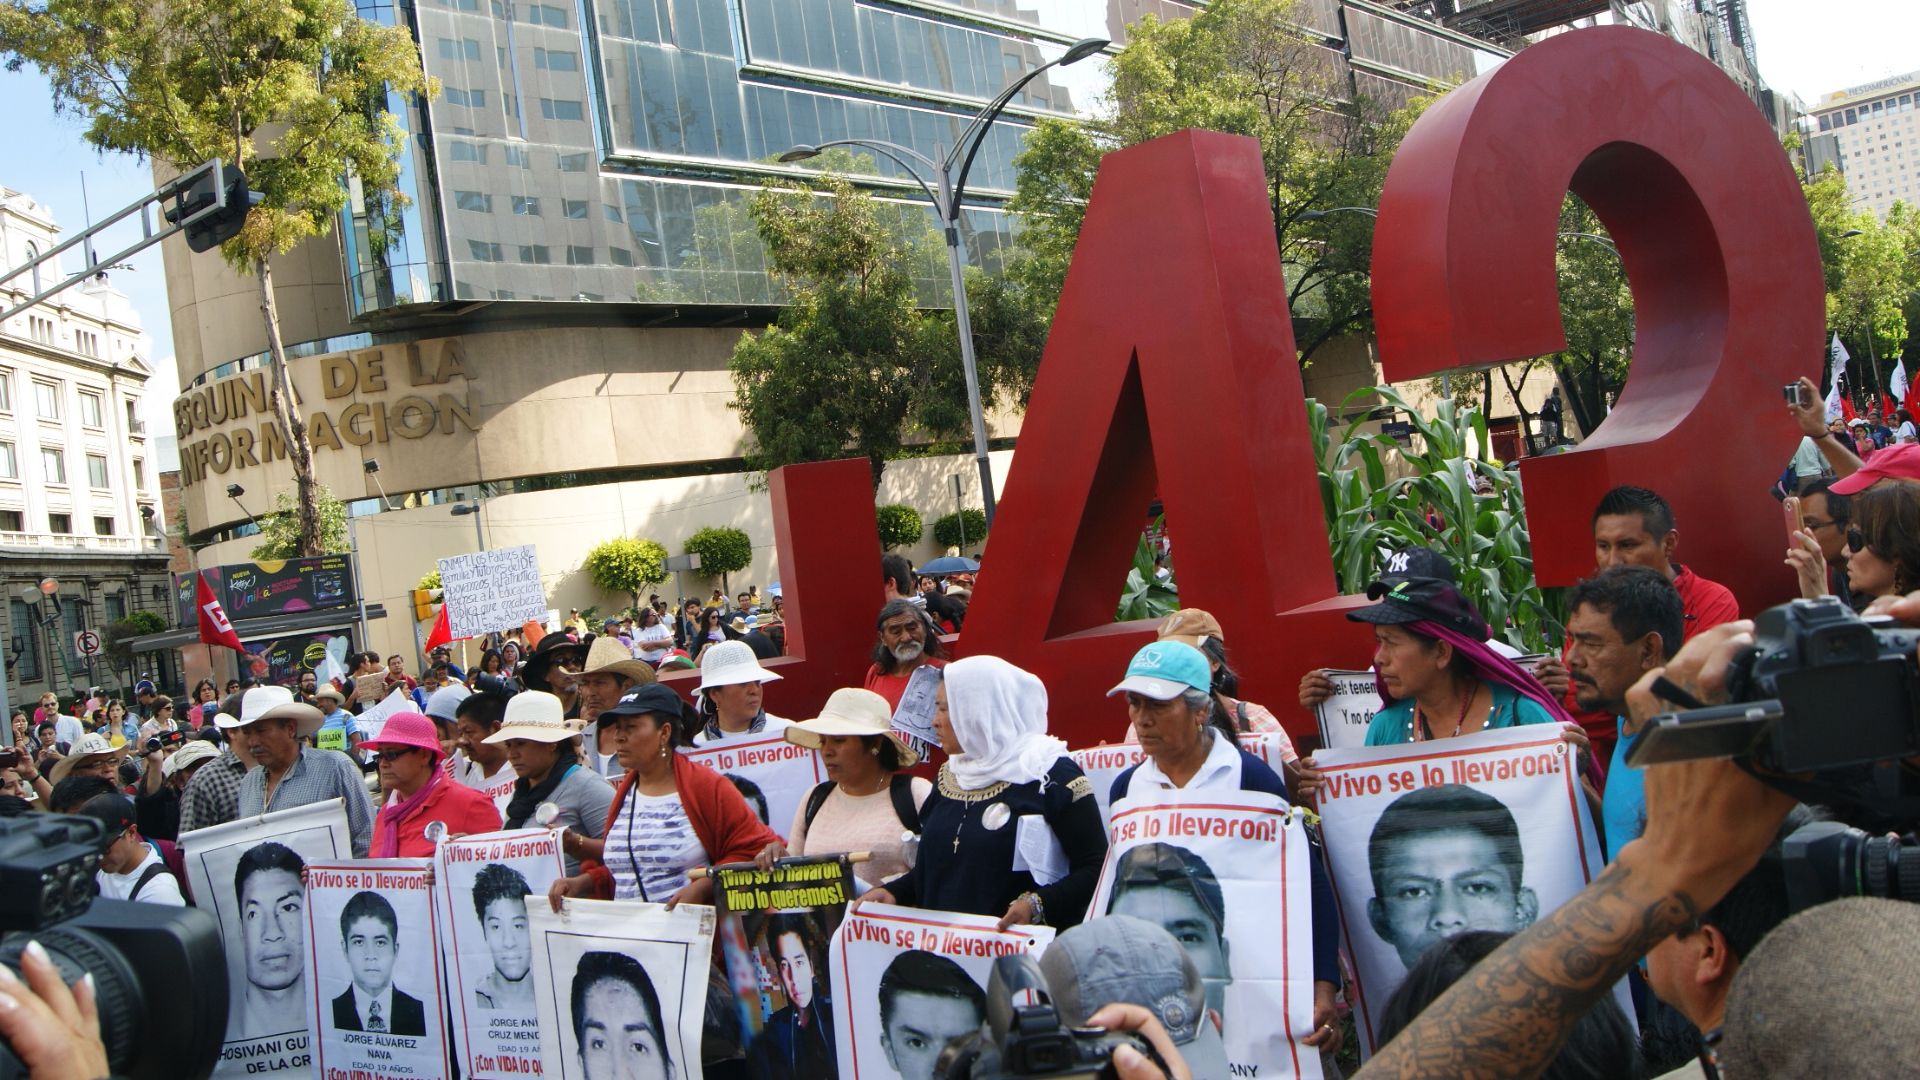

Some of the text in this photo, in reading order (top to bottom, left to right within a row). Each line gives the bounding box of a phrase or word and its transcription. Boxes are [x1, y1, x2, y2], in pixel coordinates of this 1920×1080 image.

[319, 351, 387, 399] DE
[405, 338, 478, 387] LA
[180, 389, 483, 487] INFORMACION
[1350, 712, 1362, 725] no
[718, 754, 734, 770] lo
[738, 744, 809, 766] llevaron!
[1390, 770, 1415, 792] se
[1421, 763, 1445, 788] lo
[1451, 752, 1561, 786] llevaron!
[1121, 820, 1137, 841] se
[1143, 815, 1160, 838] lo
[1168, 813, 1276, 842] llevaron!
[446, 840, 555, 865] ¡Vivo se lo llevaron!
[310, 872, 427, 890] ¡Vivo se lo llevaron!
[727, 882, 845, 911] Vivo lo queremos!
[847, 919, 890, 944] ¡Vivo
[895, 929, 915, 948] se
[919, 928, 938, 953] lo
[489, 1018, 519, 1027] JORGE
[343, 1033, 417, 1049] JORGE ÁLVAREZ
[488, 1030, 512, 1039] CRUZ
[367, 1049, 392, 1060] NAVA
[498, 1045, 517, 1053] EDAD
[246, 1061, 267, 1074] DE
[269, 1058, 289, 1071] LA
[352, 1061, 413, 1073] EDAD 19 AÑOS
[475, 1054, 495, 1073] ¡Con
[496, 1055, 519, 1073] VIDA
[519, 1056, 530, 1073] lo
